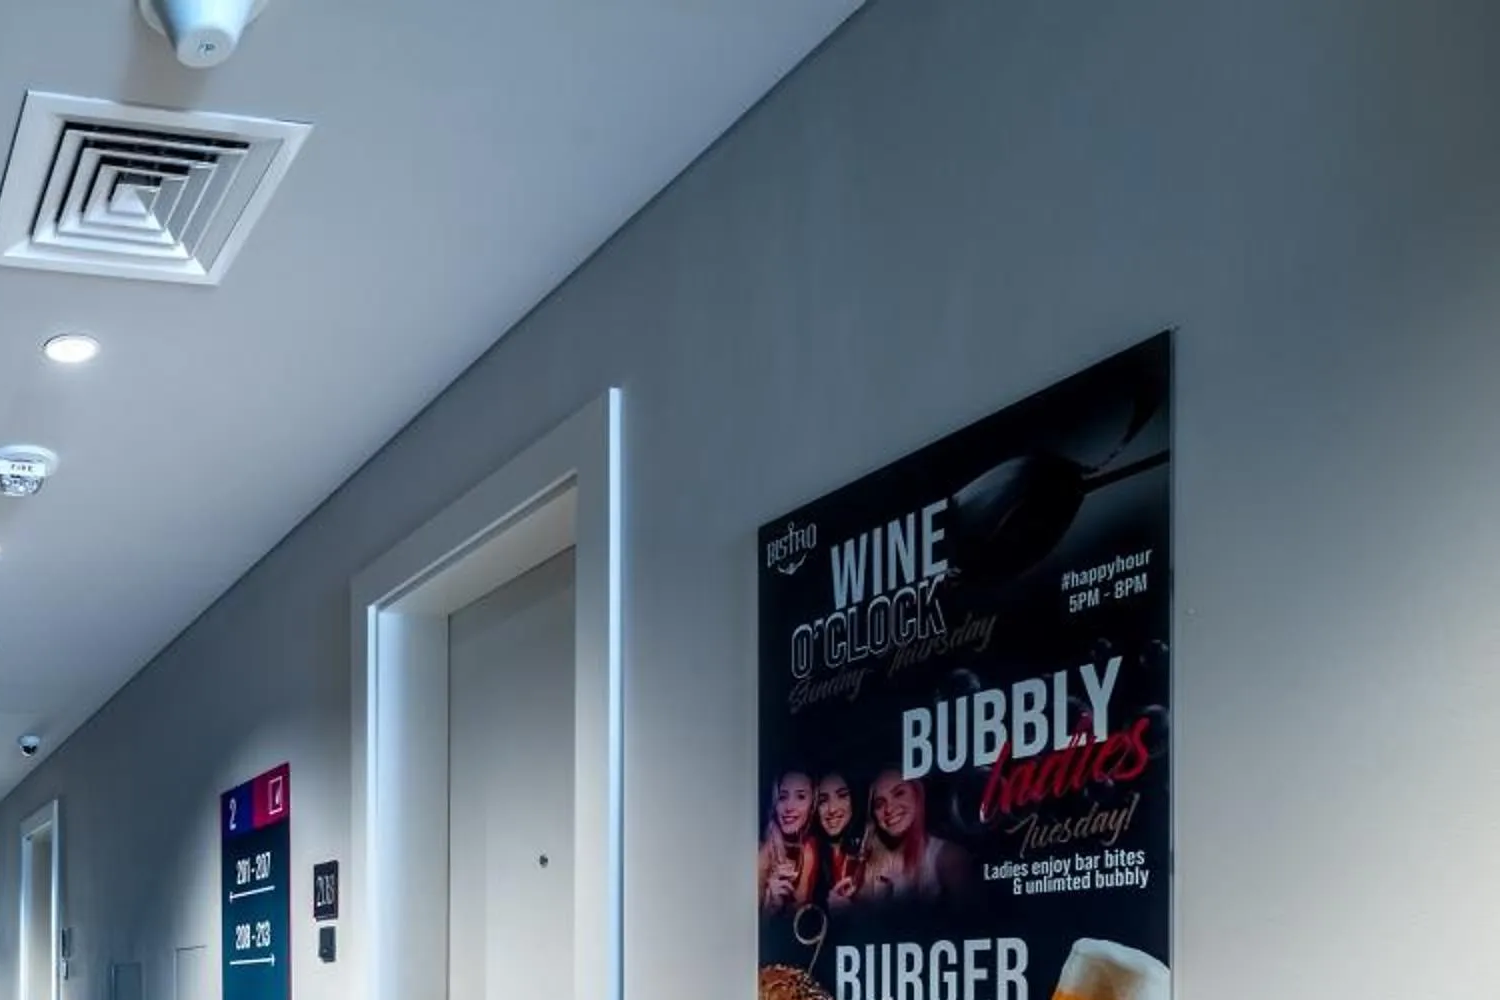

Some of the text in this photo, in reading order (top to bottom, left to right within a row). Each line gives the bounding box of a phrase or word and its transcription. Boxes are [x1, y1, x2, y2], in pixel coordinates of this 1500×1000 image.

[829, 497, 949, 611] WINE
[1061, 549, 1153, 591] #happyhour
[1069, 587, 1100, 613] 5PM
[1114, 572, 1148, 599] 8PM
[790, 573, 948, 681] O'CLOCK
[903, 655, 1124, 781] BUBBLY
[229, 797, 237, 831] 2
[983, 849, 1146, 881] Ladies enjoy bar bites
[1013, 877, 1023, 896] &
[1095, 866, 1150, 890] bubbly
